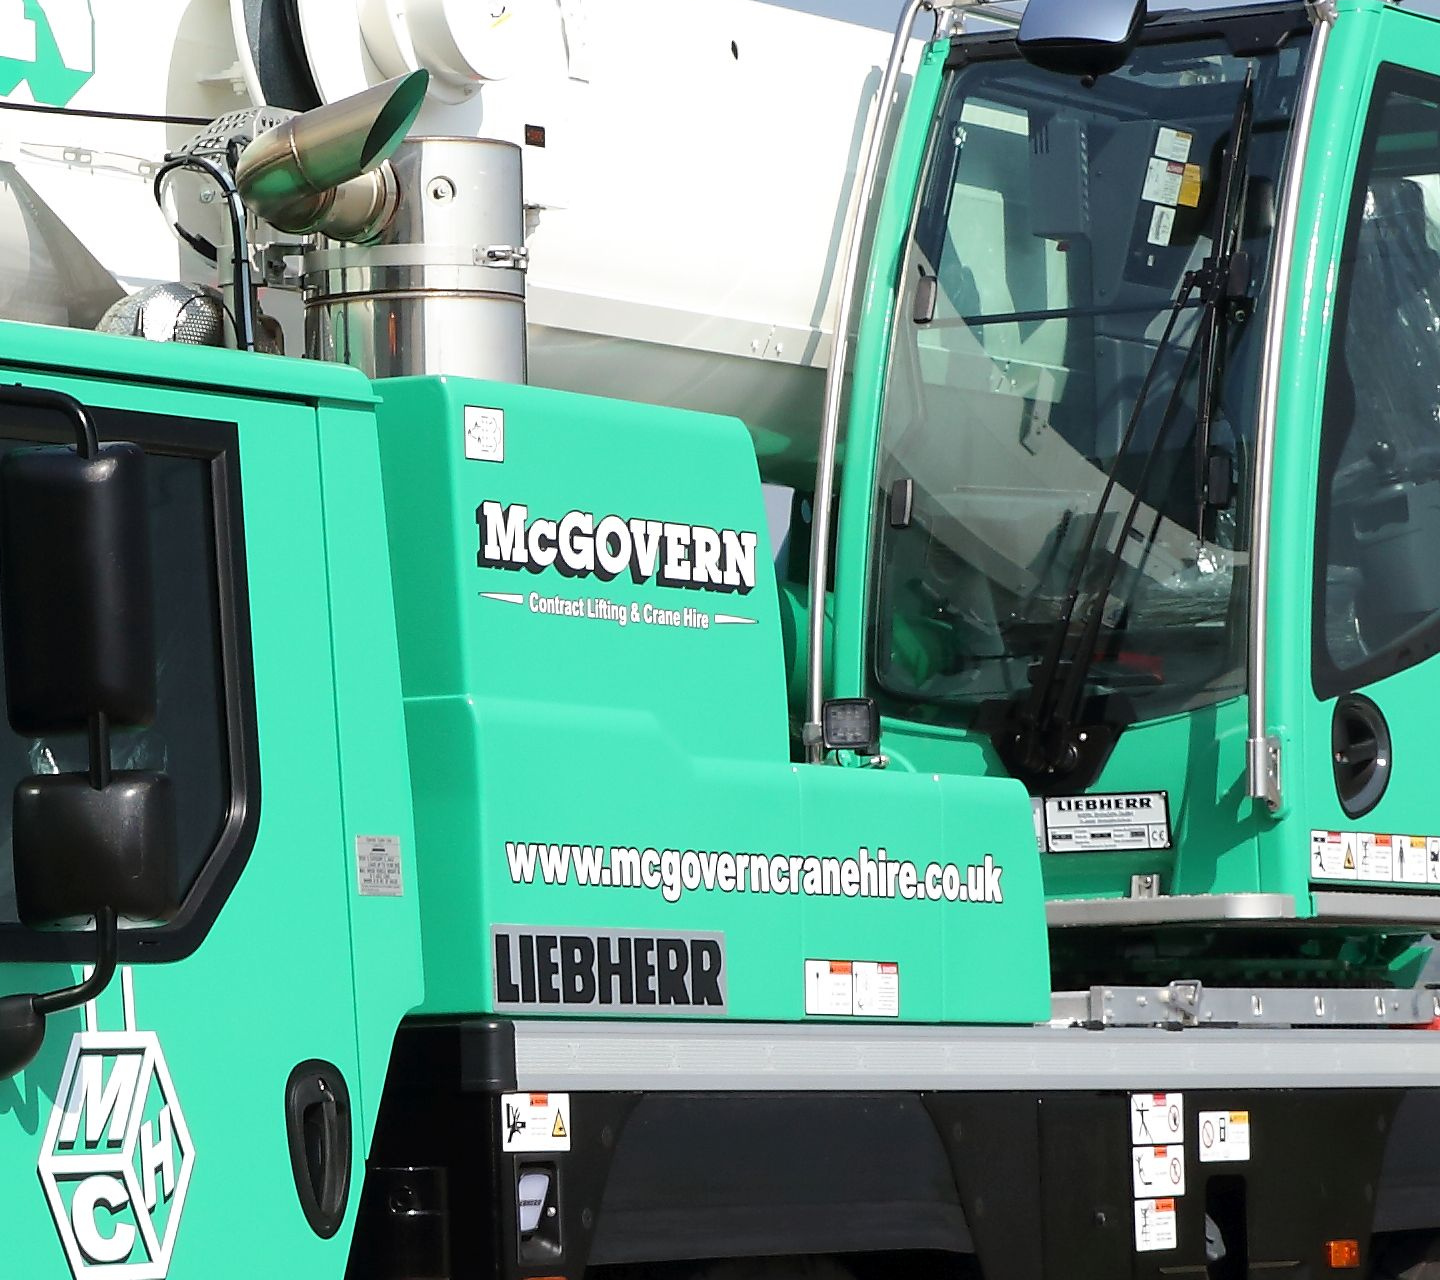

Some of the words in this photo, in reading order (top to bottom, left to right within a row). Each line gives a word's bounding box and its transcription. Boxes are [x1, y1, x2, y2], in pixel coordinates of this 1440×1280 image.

[475, 500, 758, 596] McGOVERN
[529, 591, 585, 617] Contract
[587, 598, 627, 626] Lifting
[630, 602, 640, 620] &
[643, 603, 681, 627] Crane
[683, 607, 710, 629] Hire
[1057, 797, 1152, 811] LIEBHERR
[505, 841, 1004, 904] www.mcgoverncranehire.co.uk
[495, 933, 724, 1007] LIEBHERR
